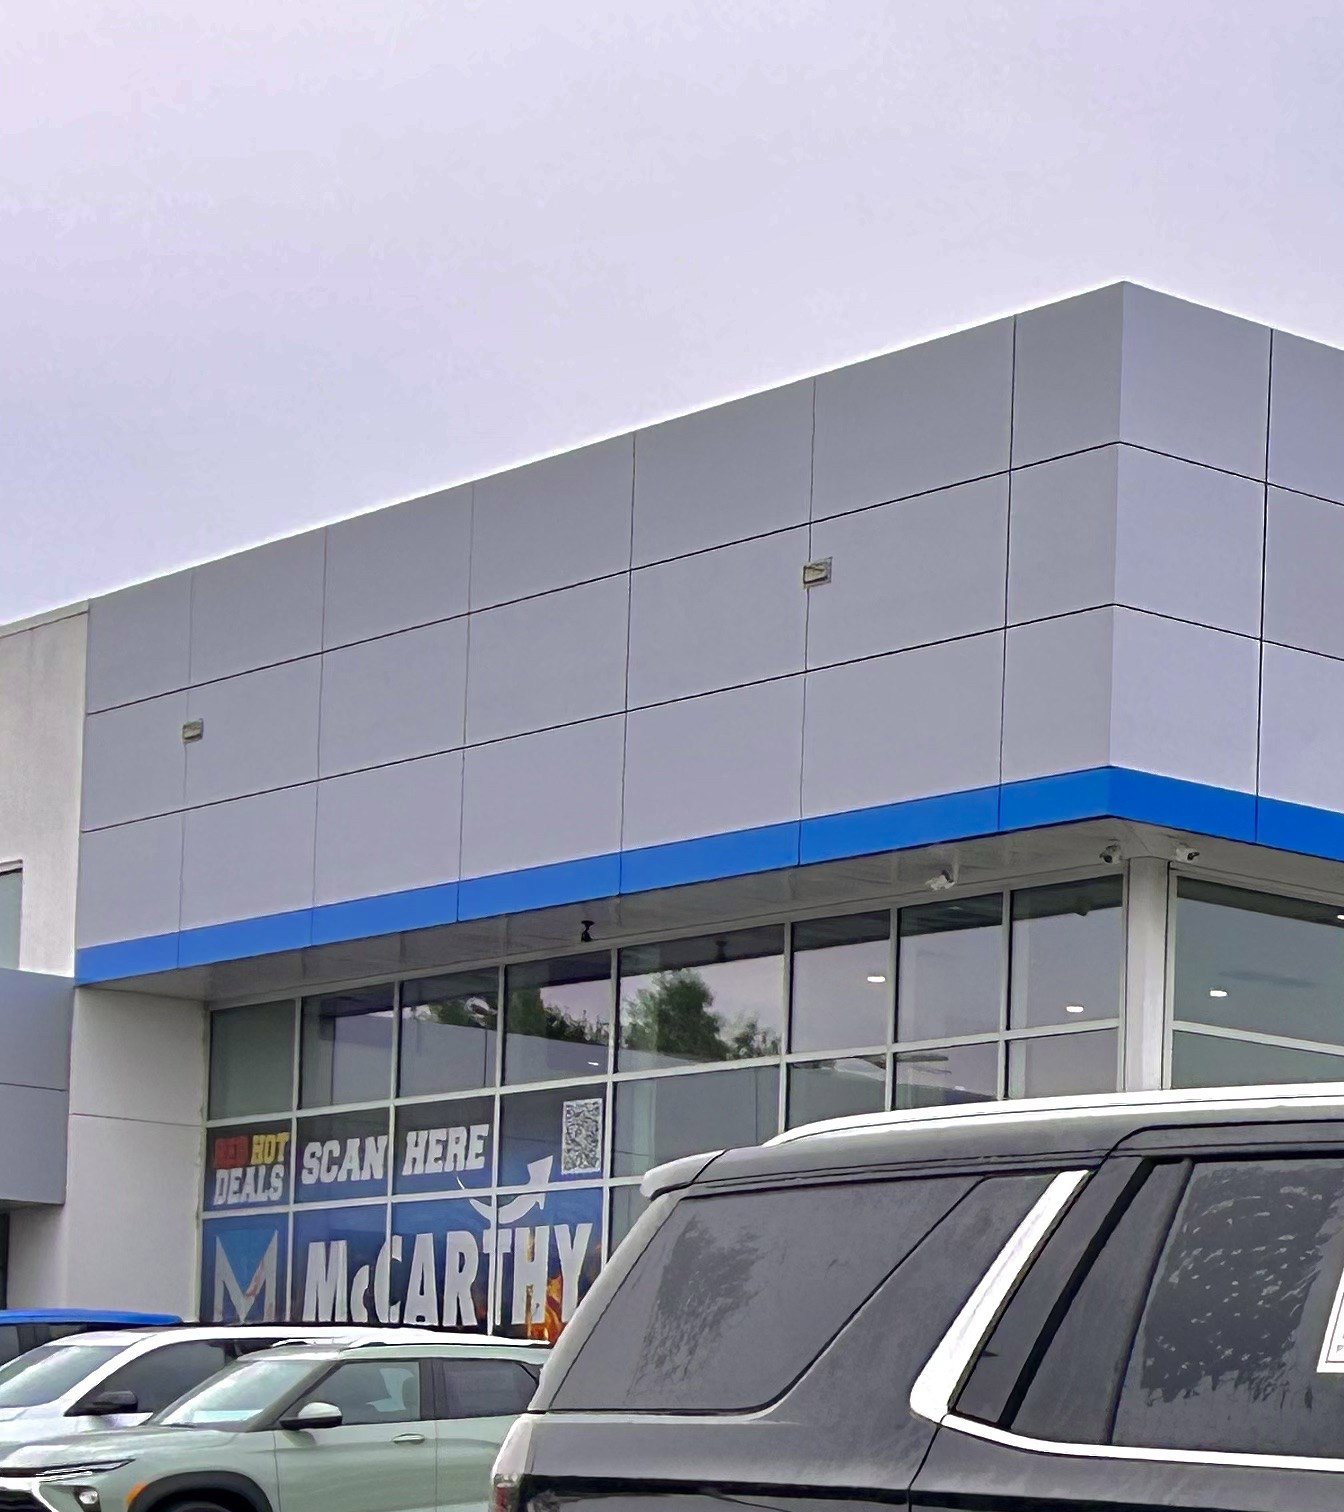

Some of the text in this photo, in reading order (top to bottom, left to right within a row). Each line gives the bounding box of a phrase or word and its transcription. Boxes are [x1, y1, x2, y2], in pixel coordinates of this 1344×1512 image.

[250, 1131, 290, 1165] HOT
[301, 1123, 490, 1185] SCAN HERE
[213, 1163, 285, 1205] DEALS
[302, 1222, 594, 1327] McCARTHY
